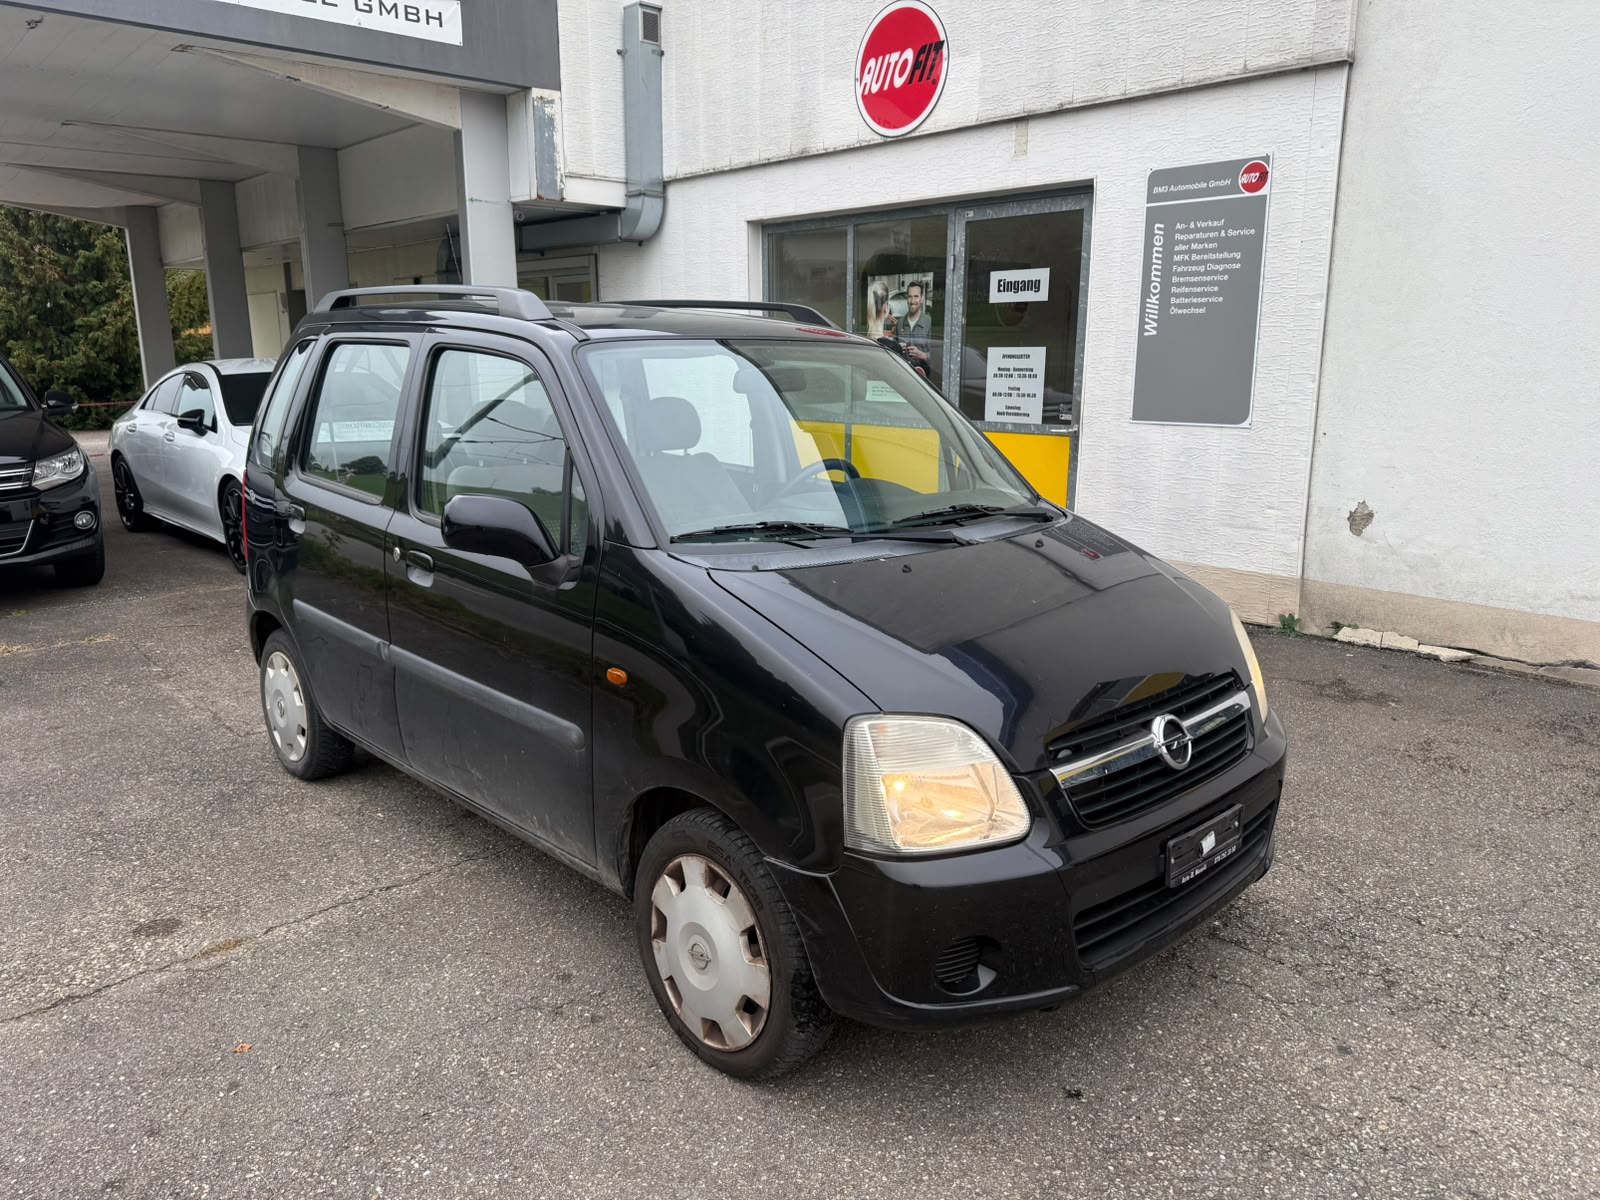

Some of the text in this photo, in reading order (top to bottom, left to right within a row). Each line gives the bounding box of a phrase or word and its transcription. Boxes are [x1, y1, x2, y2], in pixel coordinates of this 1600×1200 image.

[354, 0, 443, 28] GMBH
[861, 39, 945, 96] AUTOFIT
[1240, 171, 1269, 184] AUTOFIT
[1153, 178, 1231, 194] BM3 Automobile GmbH
[1175, 219, 1225, 230] An- & Verkauf
[1174, 231, 1219, 241] Reparaturen
[1227, 228, 1255, 237] Service
[1174, 241, 1218, 251] aller Marken
[1173, 251, 1241, 262] MFK Bereitstellung
[1172, 262, 1241, 273] Fahrzeug Diagnose
[1143, 223, 1165, 336] Willkommen
[1172, 274, 1229, 283] Bremsenservice
[997, 279, 1041, 294] Eingang
[1171, 285, 1219, 294] Reifenservice
[1170, 295, 1223, 304] Batterieservice
[1169, 306, 1206, 315] Ölwechsel
